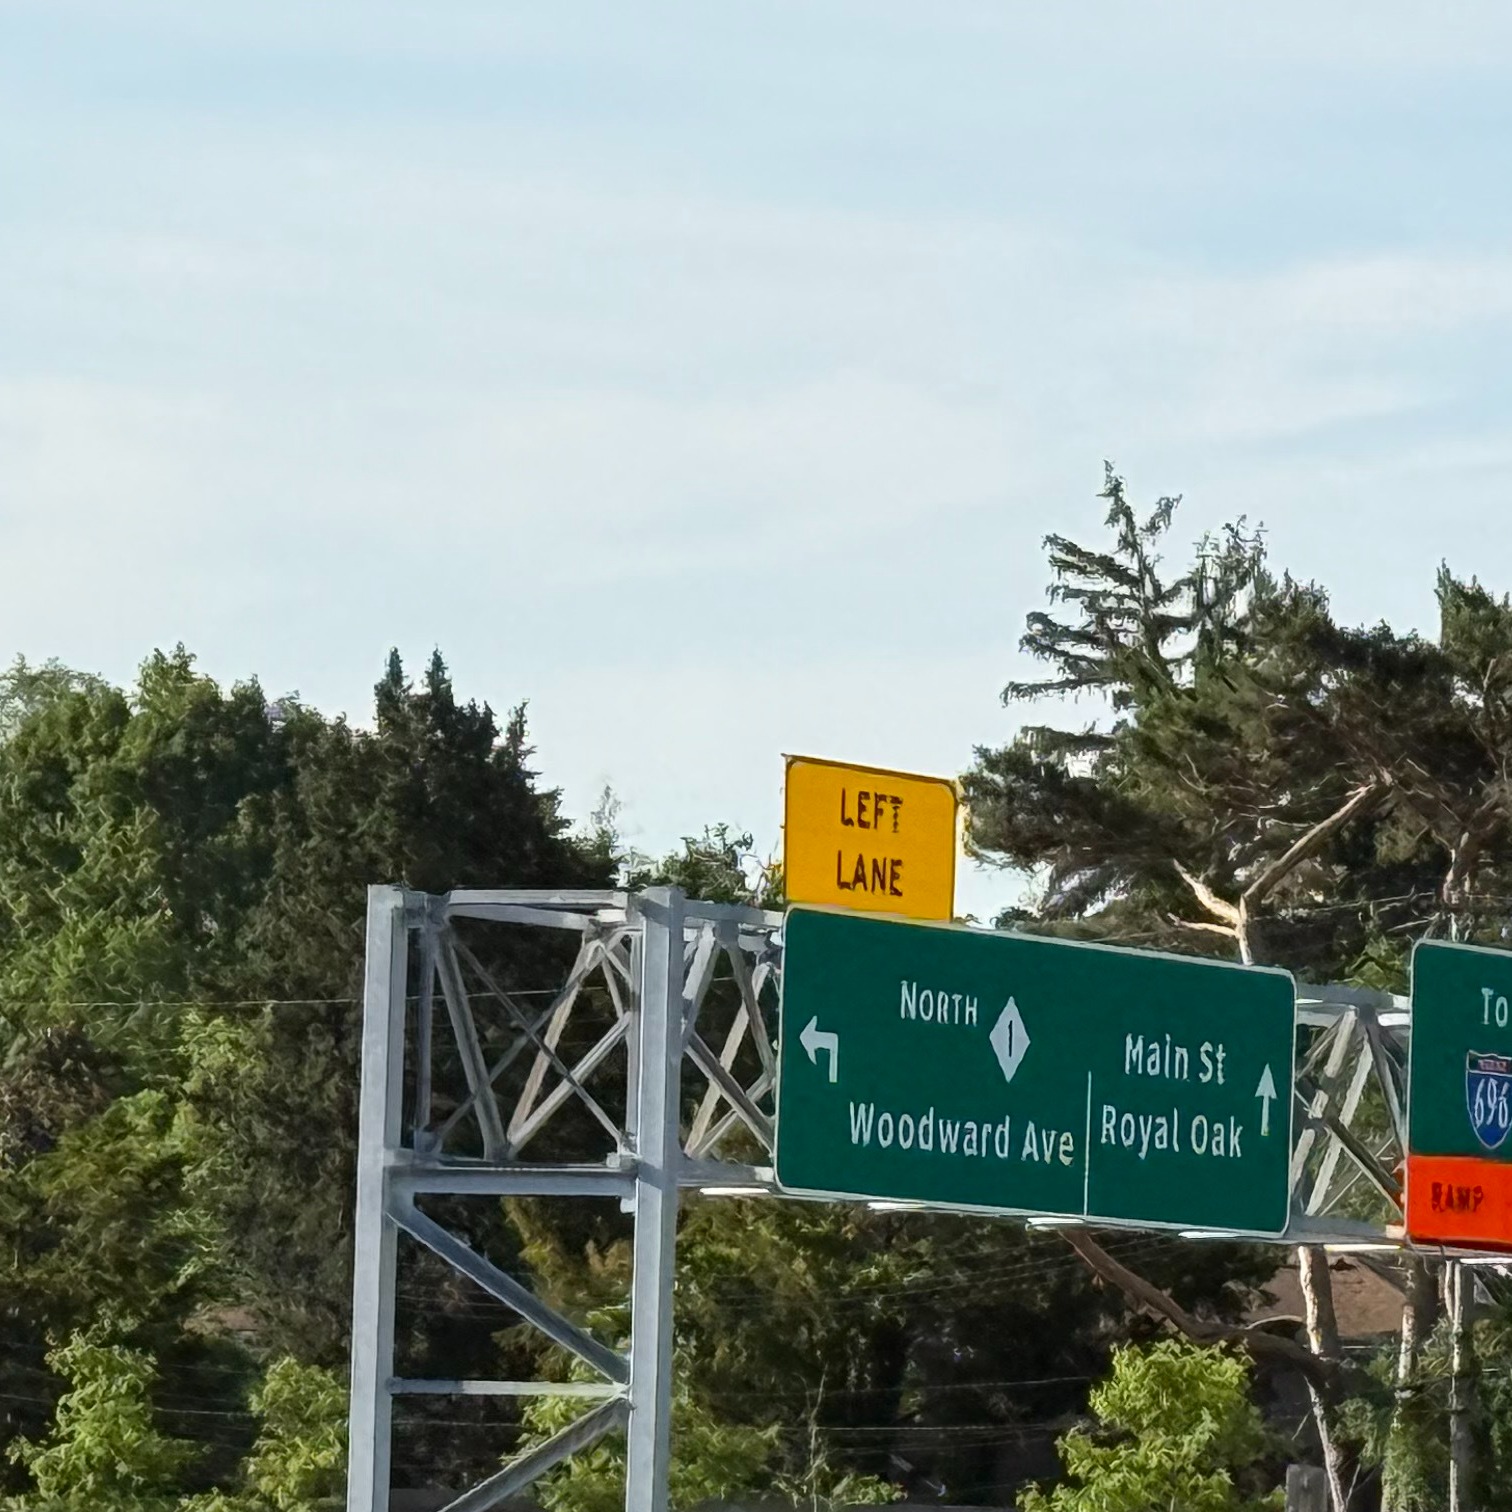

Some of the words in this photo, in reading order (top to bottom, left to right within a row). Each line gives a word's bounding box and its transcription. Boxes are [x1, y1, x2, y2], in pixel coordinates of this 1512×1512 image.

[841, 788, 903, 833] LEFT
[837, 850, 903, 897] LANE
[1124, 1033, 1189, 1081] Main
[1199, 1043, 1226, 1085] St
[1474, 1076, 1511, 1129] 696
[849, 1102, 1011, 1159] Woodward
[1021, 1121, 1075, 1166] Ave
[1101, 1104, 1179, 1159] Royal
[1190, 1114, 1243, 1158] Oak
[1431, 1181, 1484, 1213] RAMP
